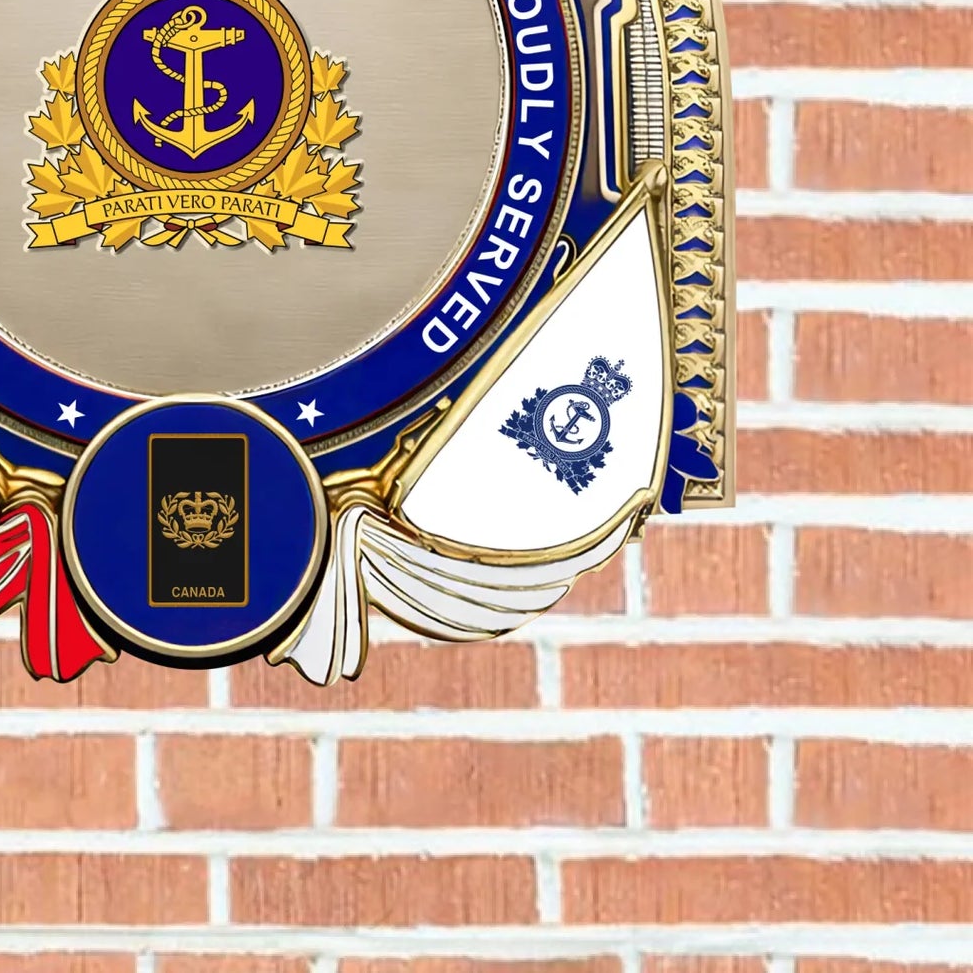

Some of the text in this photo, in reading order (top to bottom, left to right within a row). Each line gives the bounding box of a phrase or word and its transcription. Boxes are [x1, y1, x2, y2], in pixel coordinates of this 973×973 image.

[102, 194, 281, 218] PARATI VERO PARATI
[421, 174, 543, 353] SERVED
[171, 586, 226, 598] CANADA
